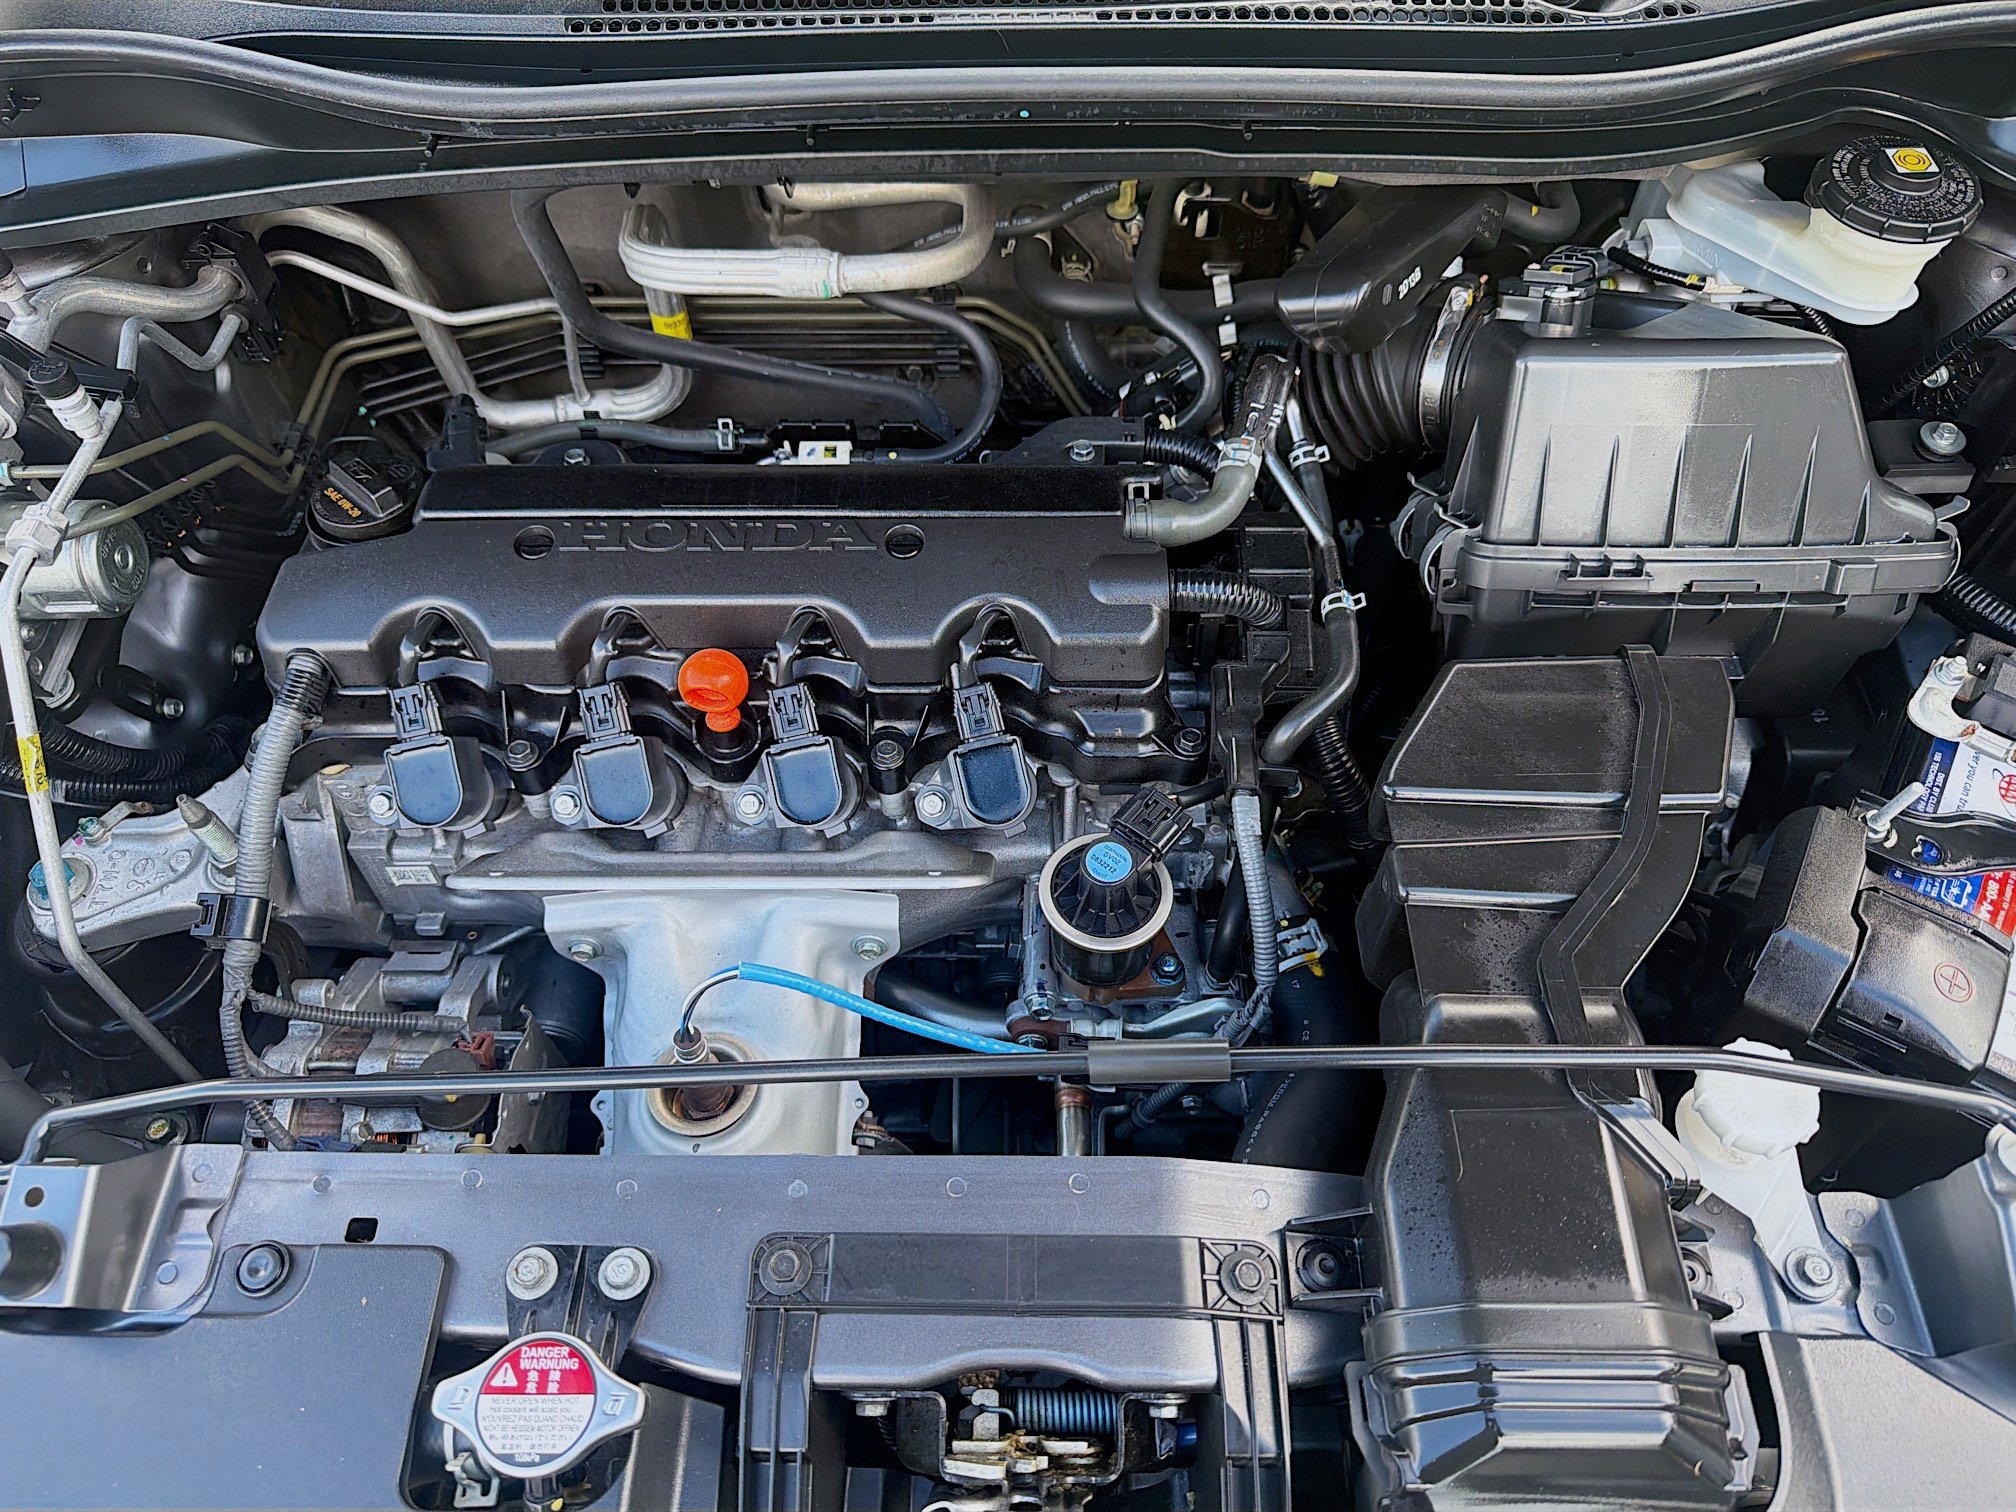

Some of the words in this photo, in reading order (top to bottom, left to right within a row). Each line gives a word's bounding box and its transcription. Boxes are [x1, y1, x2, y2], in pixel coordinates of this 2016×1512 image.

[323, 486, 344, 503] SAE
[338, 498, 362, 518] 0W-20
[559, 521, 878, 553] HONDA
[1966, 763, 1978, 781] you
[1961, 782, 1972, 797] can
[1925, 796, 1938, 814] CLUB
[521, 1346, 571, 1358] DANGER
[520, 1358, 579, 1370] WARNUNG
[529, 1405, 538, 1413] will
[537, 1424, 556, 1432] MOTOR
